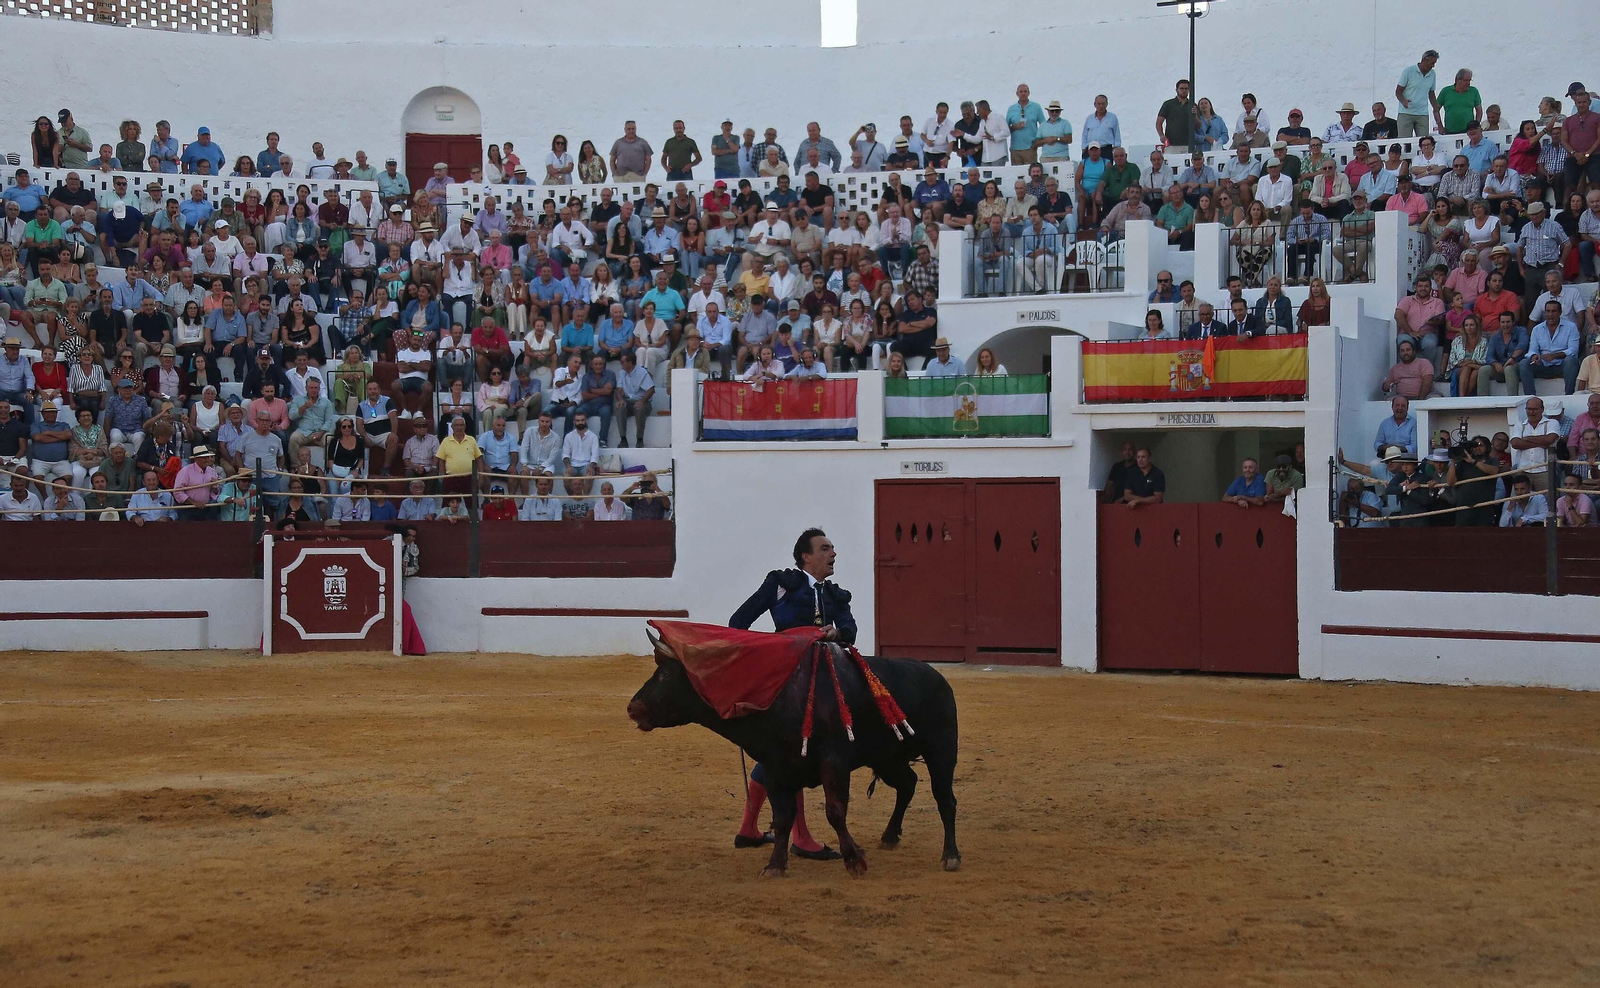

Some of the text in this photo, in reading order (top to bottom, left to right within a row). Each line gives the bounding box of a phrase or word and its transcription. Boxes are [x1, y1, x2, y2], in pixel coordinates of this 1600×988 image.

[1029, 311, 1056, 320] PALCOS
[1168, 413, 1216, 424] PRESIDENCIA
[914, 461, 944, 471] TORILES
